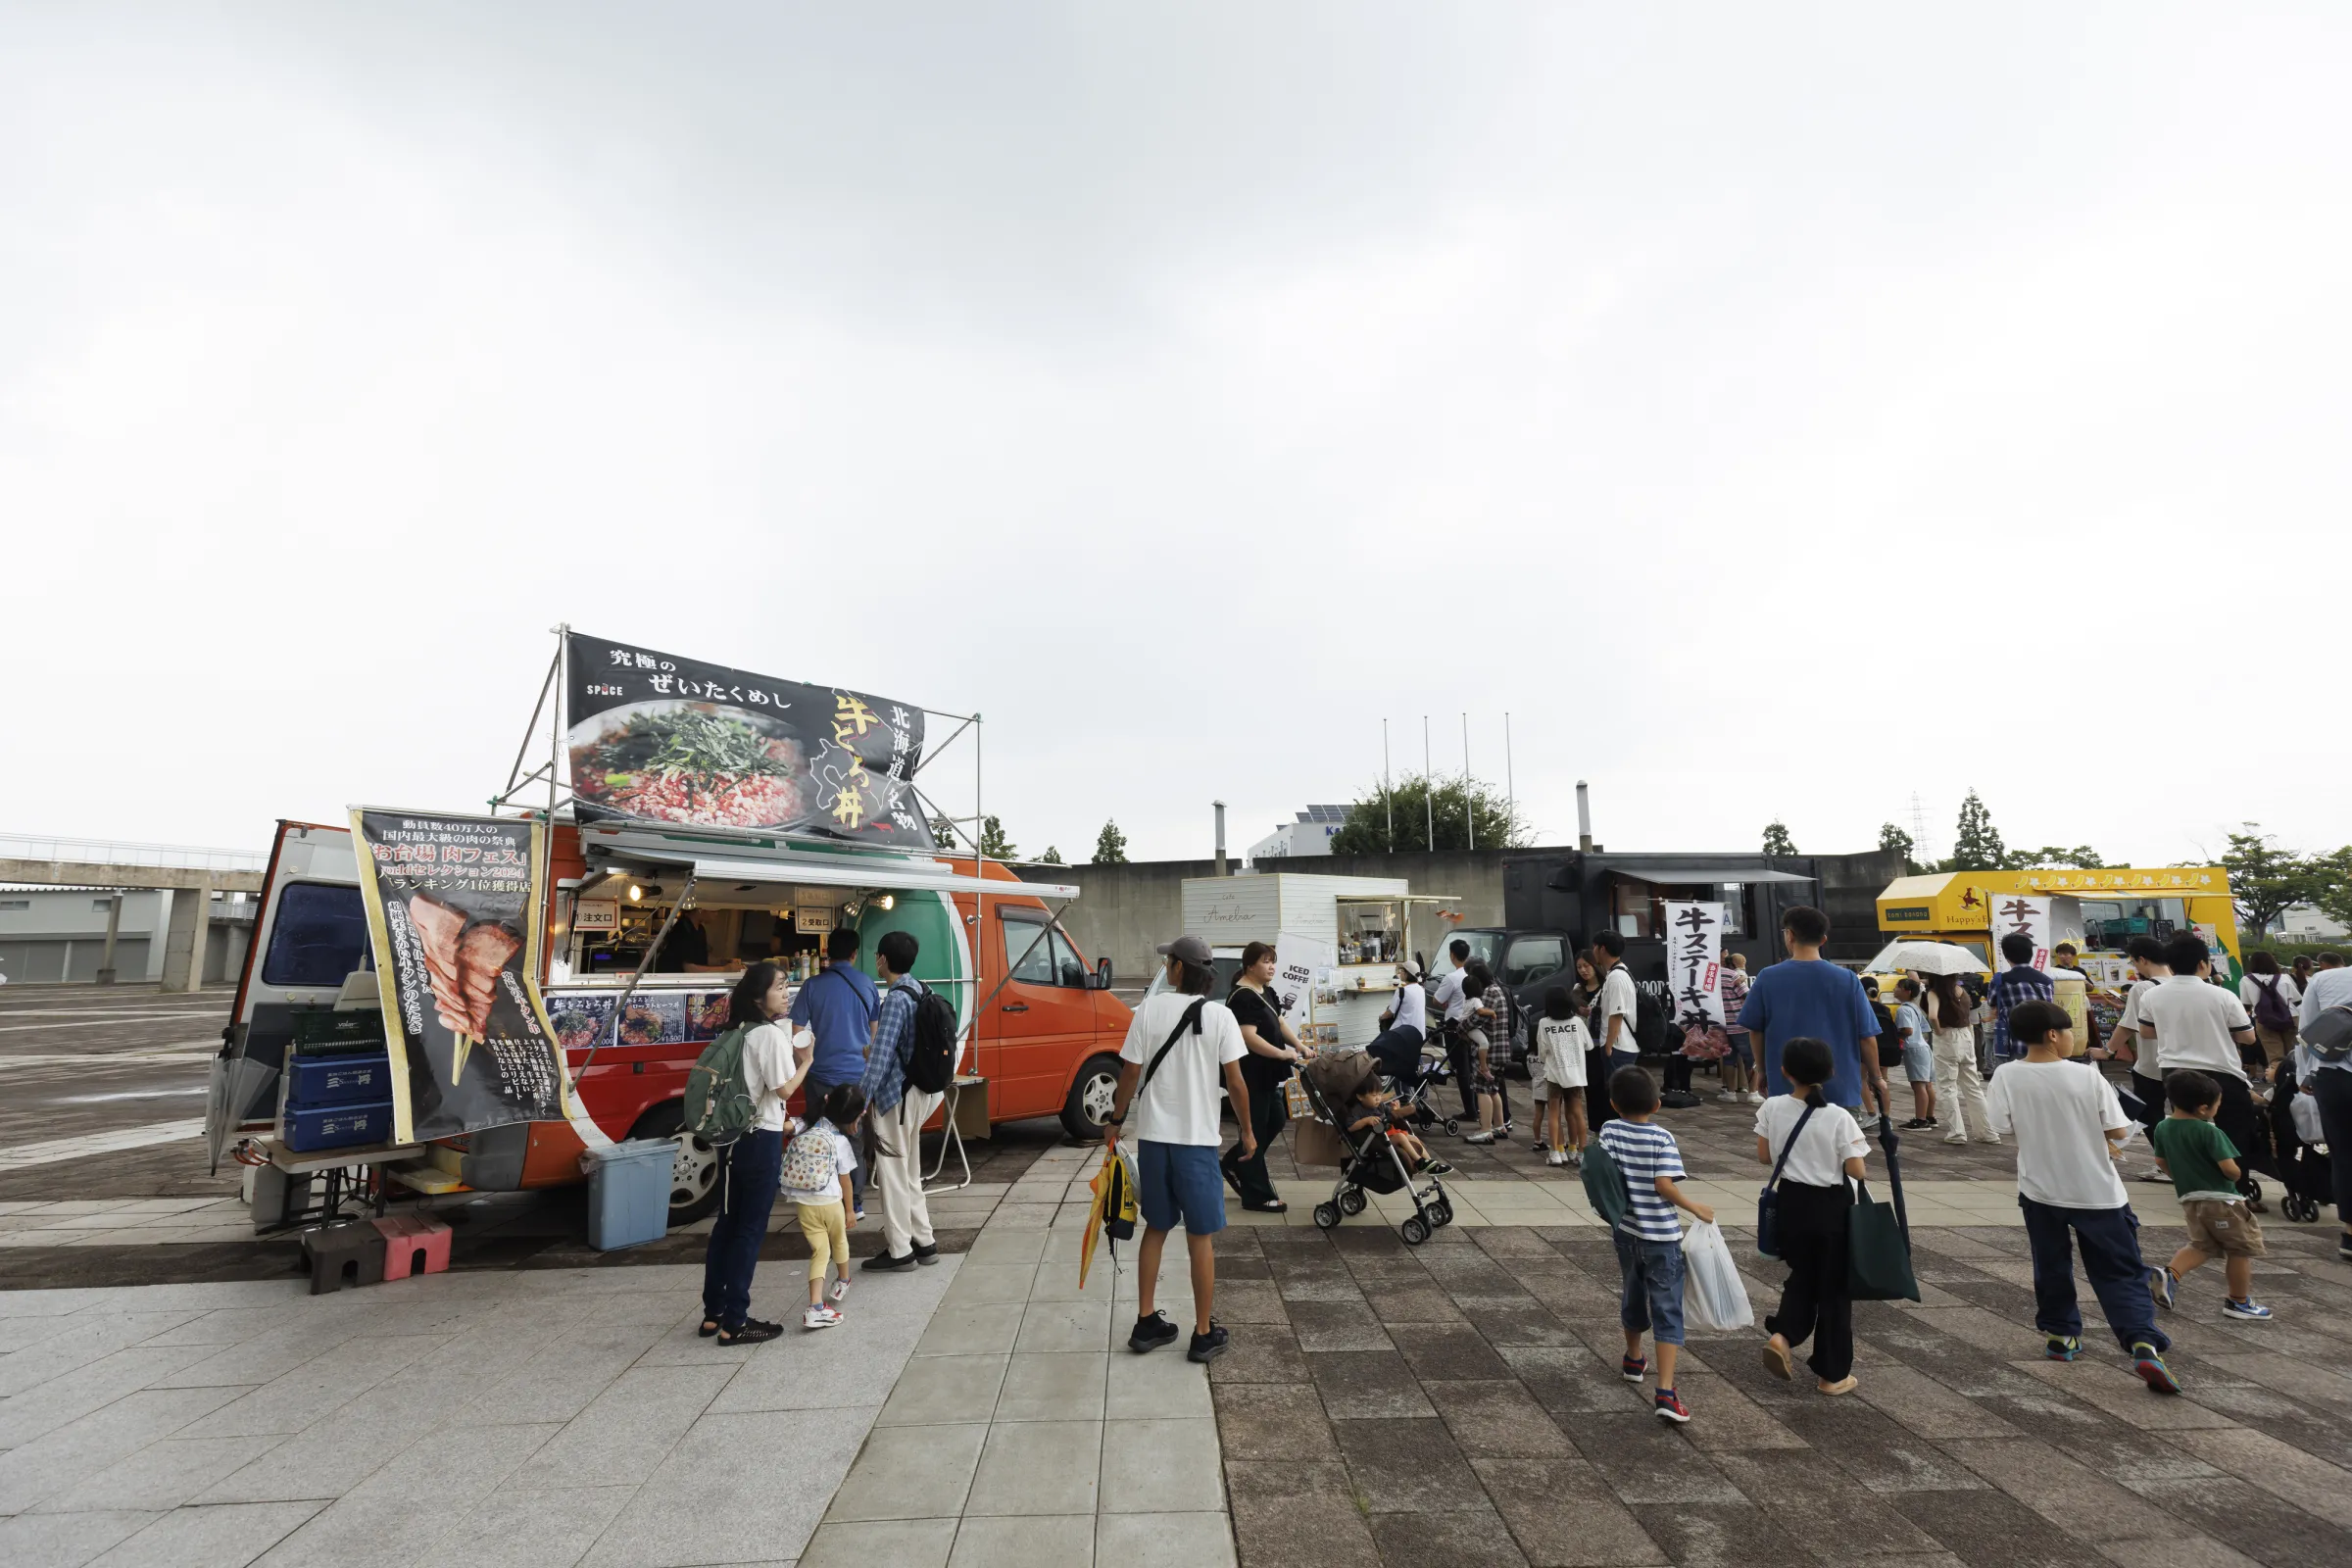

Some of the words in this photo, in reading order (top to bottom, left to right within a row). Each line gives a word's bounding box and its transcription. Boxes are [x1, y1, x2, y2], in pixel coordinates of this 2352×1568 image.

[609, 649, 677, 672] 究極の
[648, 673, 793, 710] ぜいたくめし
[830, 694, 879, 829] 牛とろ丼
[886, 705, 919, 831] 北海道名物
[402, 820, 498, 834] 動員数40万人の
[382, 830, 516, 847] 国内最大級の肉の祭典
[1946, 914, 1982, 926] Happy's
[1289, 964, 1310, 975] ICED
[1675, 906, 1721, 1035] 牛ステーキ丼
[554, 998, 613, 1010] 牛とろとろ丼
[688, 1005, 723, 1016] 牛タン串
[1544, 1024, 1577, 1035] PEACE
